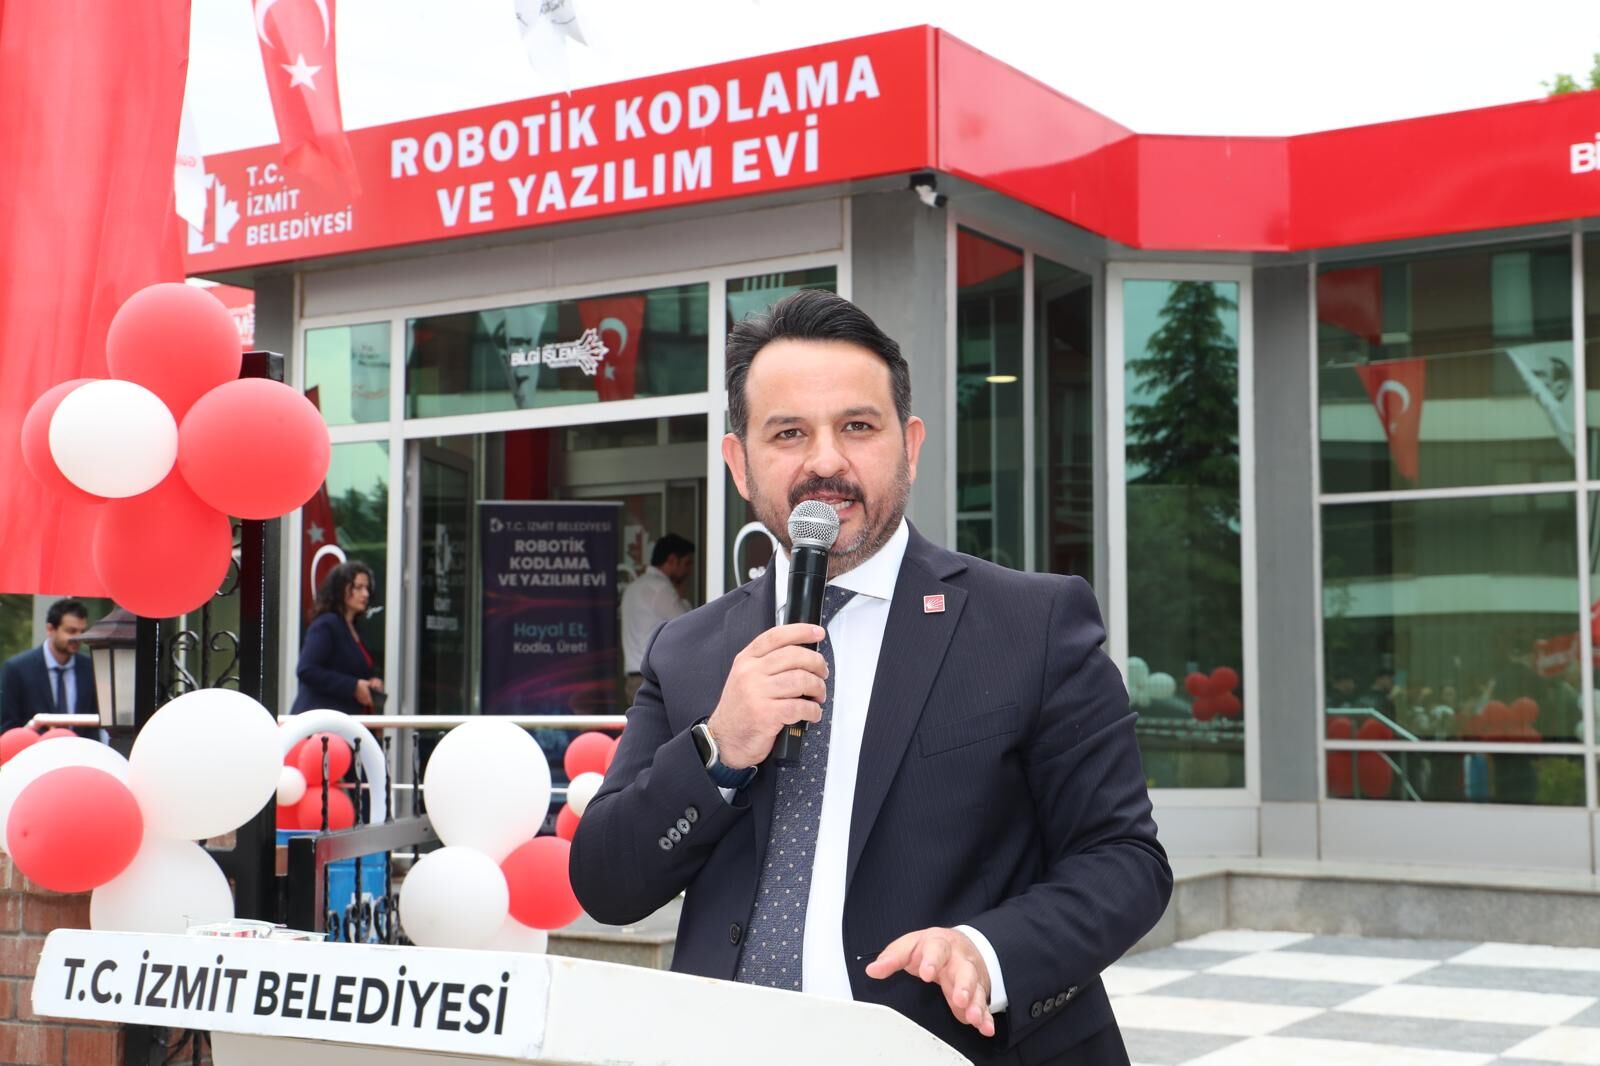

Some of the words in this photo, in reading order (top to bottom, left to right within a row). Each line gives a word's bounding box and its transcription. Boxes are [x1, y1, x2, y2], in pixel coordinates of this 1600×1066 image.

[390, 100, 599, 179] ROBOTİK
[614, 55, 880, 142] KODLAMA
[246, 165, 284, 187] T.C.
[437, 183, 494, 228] VE
[509, 146, 712, 217] YAZILIM
[732, 114, 820, 184] EVİ
[246, 186, 300, 217] İZMİT
[246, 204, 353, 247] BELEDİYESİ
[510, 347, 540, 367] BİLGİ
[506, 520, 526, 532] T.C.
[527, 519, 555, 532] İZMİT
[556, 519, 611, 532] BELEDİYESİ
[514, 536, 586, 553] ROBOTİK
[509, 556, 590, 570] KODLAMA
[498, 573, 518, 587] VE
[520, 573, 580, 586] YAZILIM
[582, 571, 607, 586] EVİ
[513, 622, 564, 640] Hayal
[513, 641, 554, 655] Kodla,
[557, 639, 588, 653] Üret!
[63, 957, 123, 1004] T.C.
[135, 950, 248, 1014] İZMİT
[254, 964, 511, 1035] BELEDİYESİ
